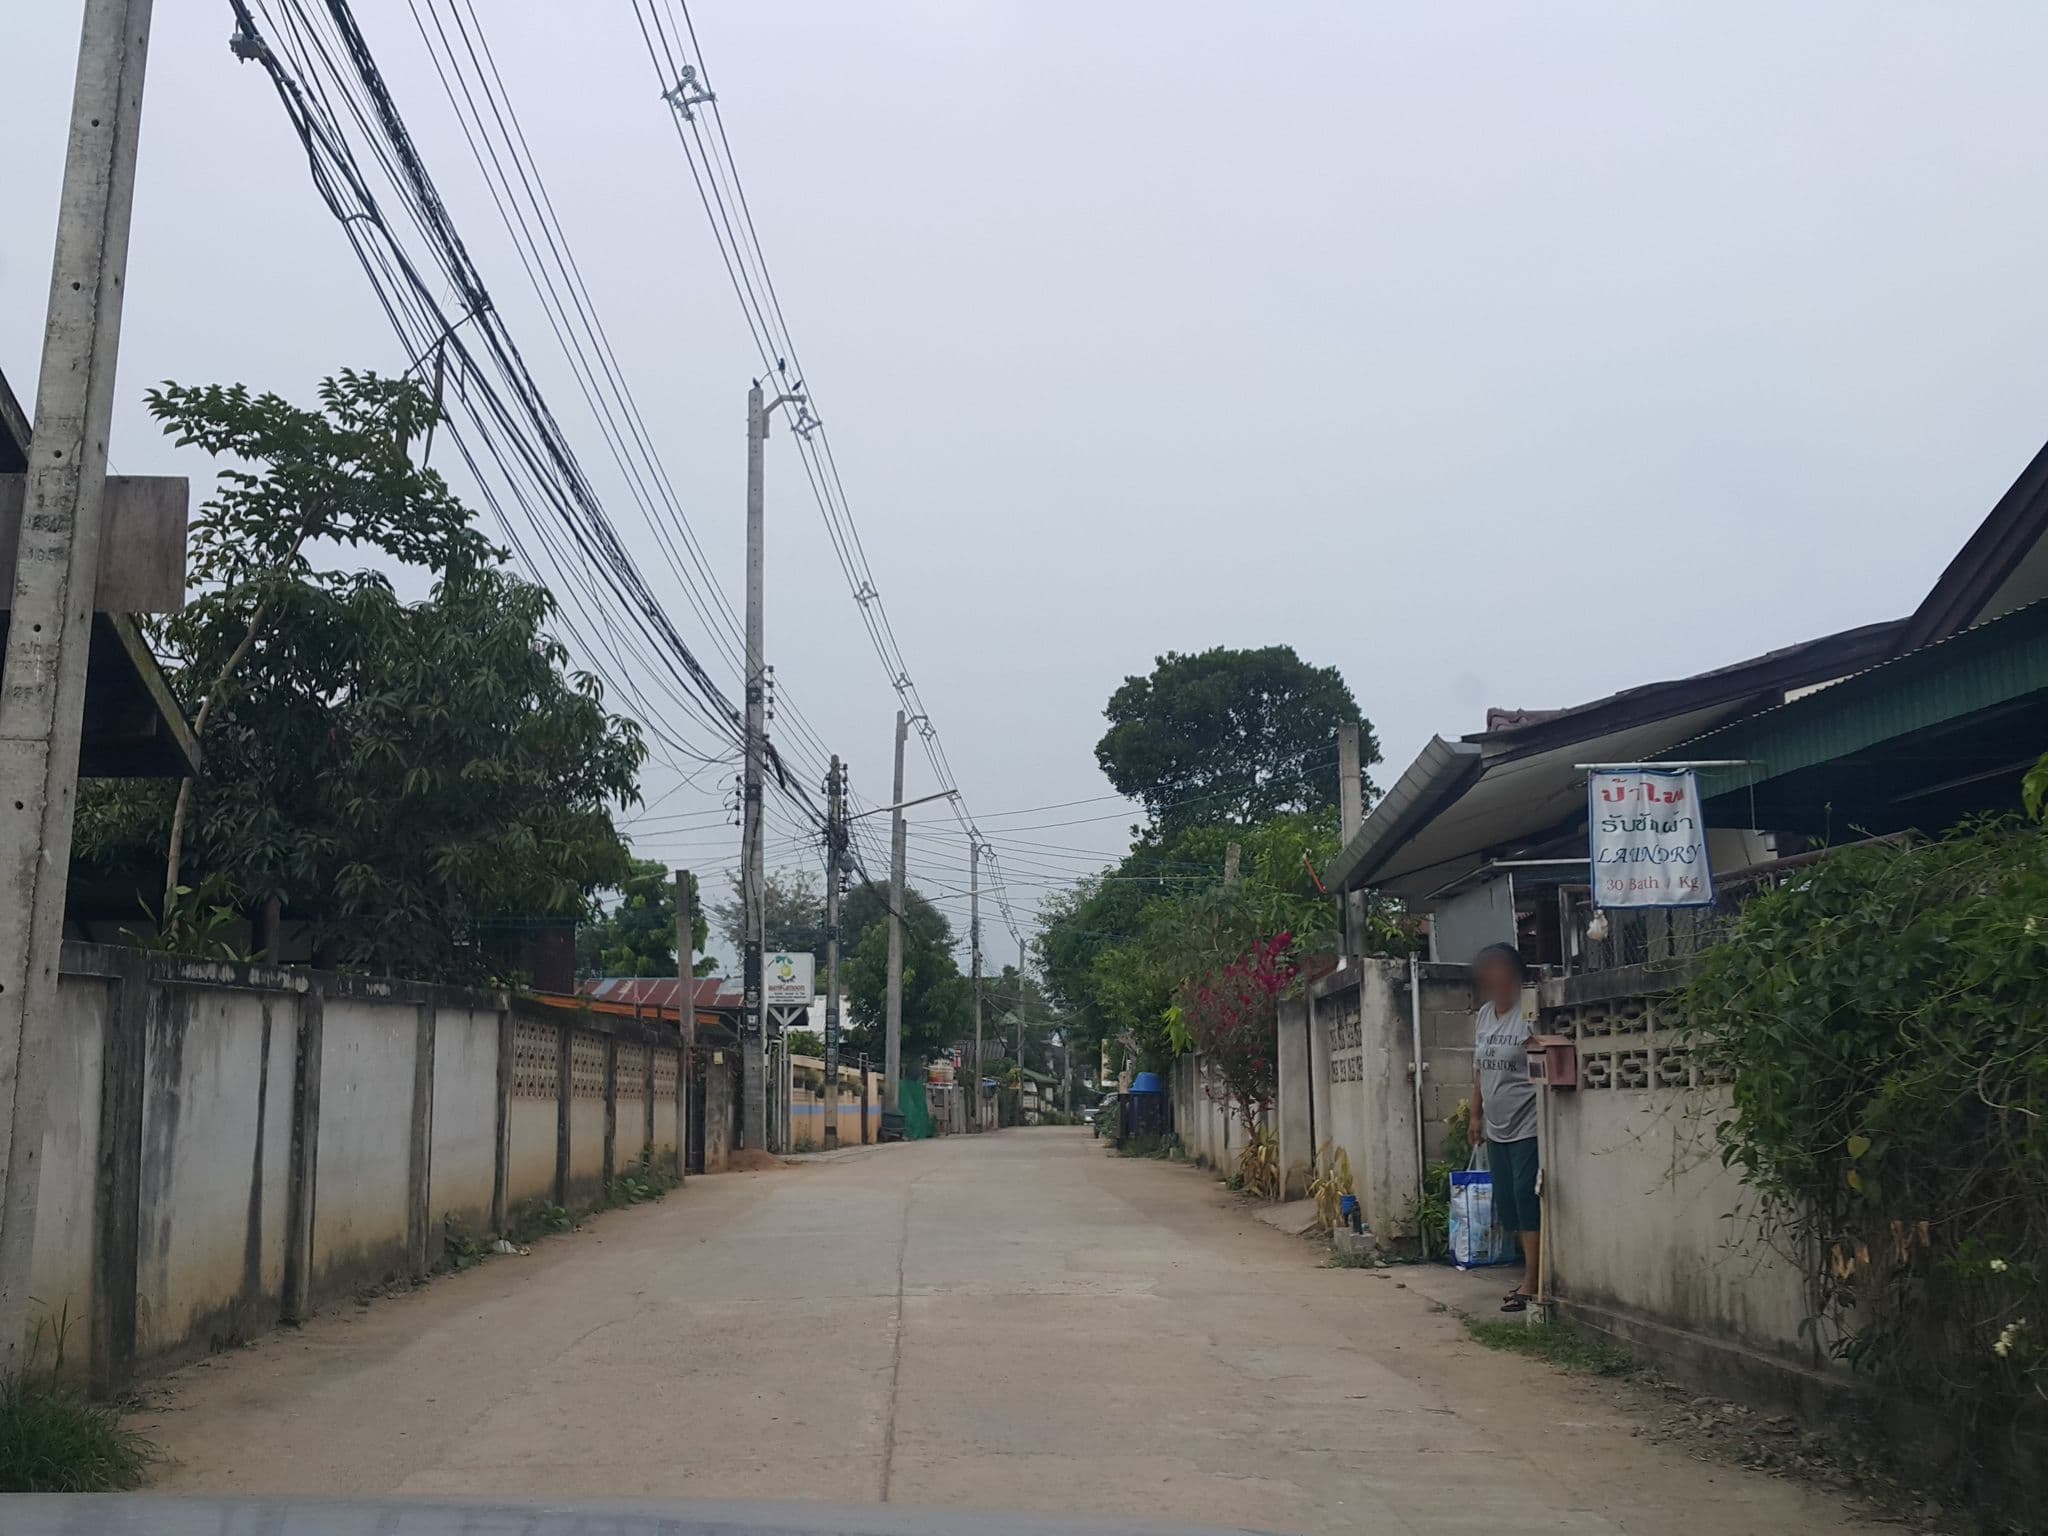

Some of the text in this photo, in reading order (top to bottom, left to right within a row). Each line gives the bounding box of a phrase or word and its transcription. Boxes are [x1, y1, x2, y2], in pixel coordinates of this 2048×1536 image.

[1598, 843, 1702, 865] LAUNDRY
[1606, 879, 1624, 891] 30
[1629, 876, 1660, 890] Bath
[1679, 876, 1700, 891] Kg
